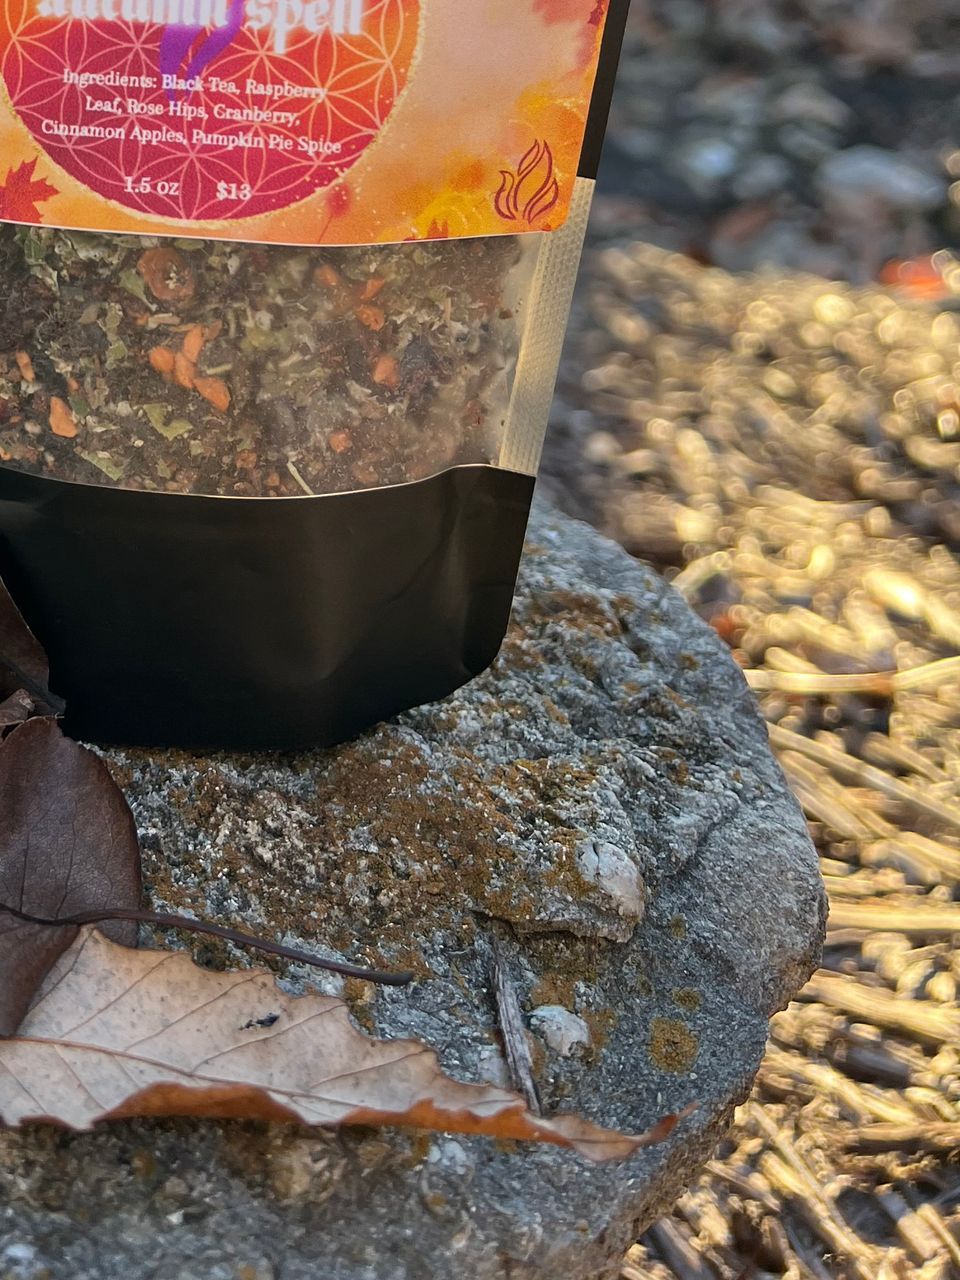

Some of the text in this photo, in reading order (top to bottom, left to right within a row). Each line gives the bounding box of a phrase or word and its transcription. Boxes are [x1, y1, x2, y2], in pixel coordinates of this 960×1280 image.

[62, 69, 328, 103] Ingredients: Black Tea, Raspberry
[85, 96, 301, 126] Leaf, Rose Hips, Cranberry,
[41, 120, 342, 155] Cinnamon Apples, Pumpkin Pie Spice
[123, 176, 252, 200] 1.5 oz $13
